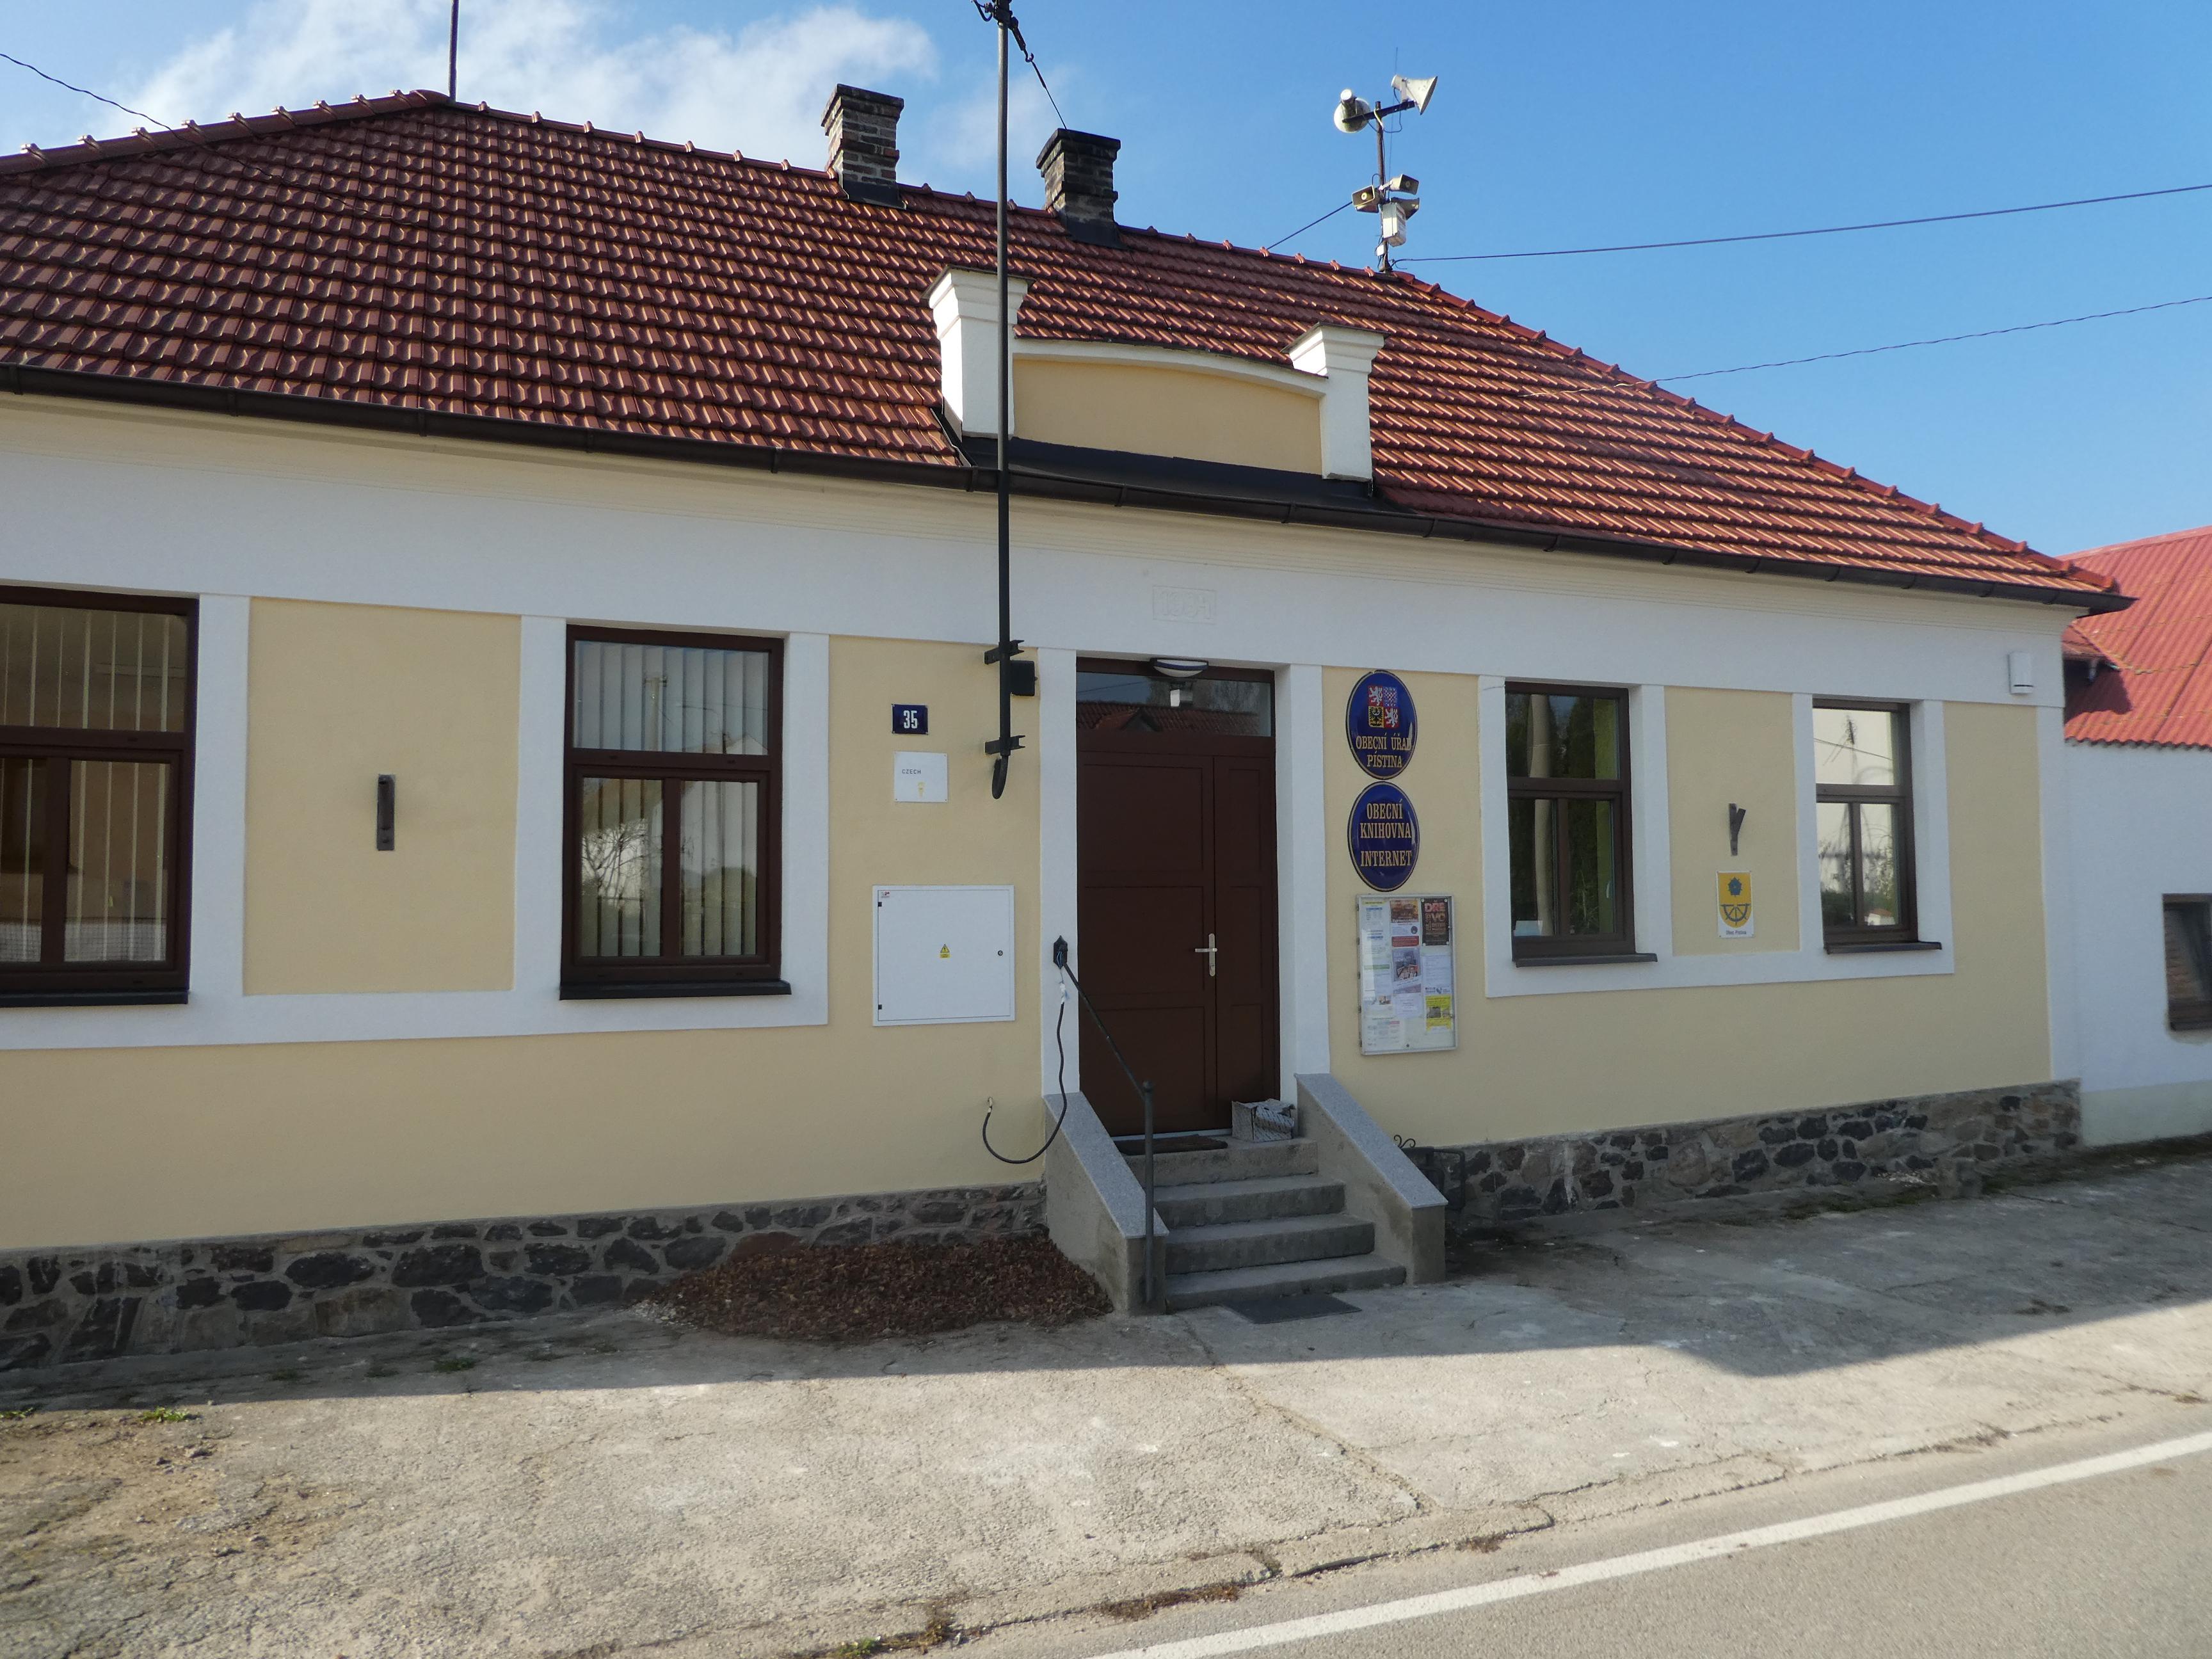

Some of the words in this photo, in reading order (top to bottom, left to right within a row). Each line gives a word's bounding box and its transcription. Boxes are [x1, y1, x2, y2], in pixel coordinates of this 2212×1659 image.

[903, 710, 918, 729] 35
[1355, 732, 1388, 750] OBECNÍ
[1366, 750, 1403, 768] PÍSTINA
[1366, 798, 1403, 819] OBECNÍ
[1360, 822, 1412, 838] KNIHOVNA
[1361, 850, 1413, 867] INTERNET
